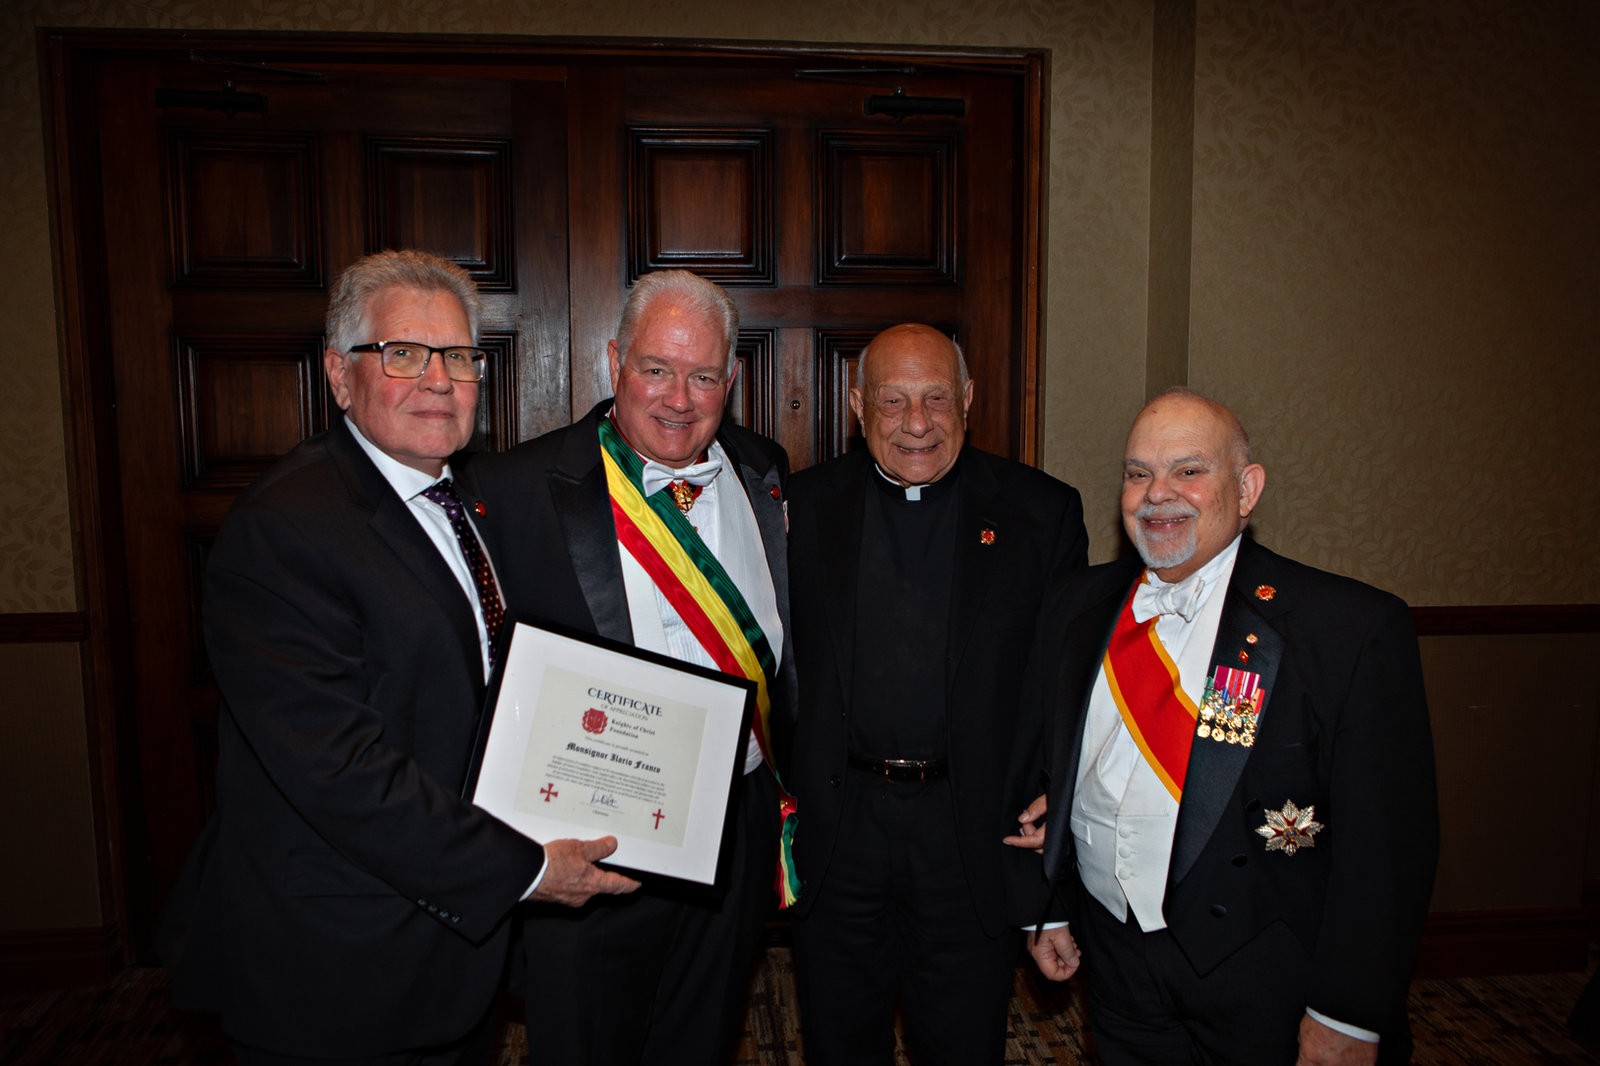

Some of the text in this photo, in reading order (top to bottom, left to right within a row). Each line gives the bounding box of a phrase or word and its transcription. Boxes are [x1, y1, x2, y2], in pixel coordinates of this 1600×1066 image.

[588, 687, 663, 717] CERTIFICATE
[610, 707, 649, 721] APPRECIATION
[610, 726, 639, 739] Foundation
[611, 719, 632, 729] Knights
[639, 726, 656, 735] Christ
[566, 742, 608, 760] Monsignor
[610, 753, 633, 766] Ilario
[634, 760, 661, 774] Franco
